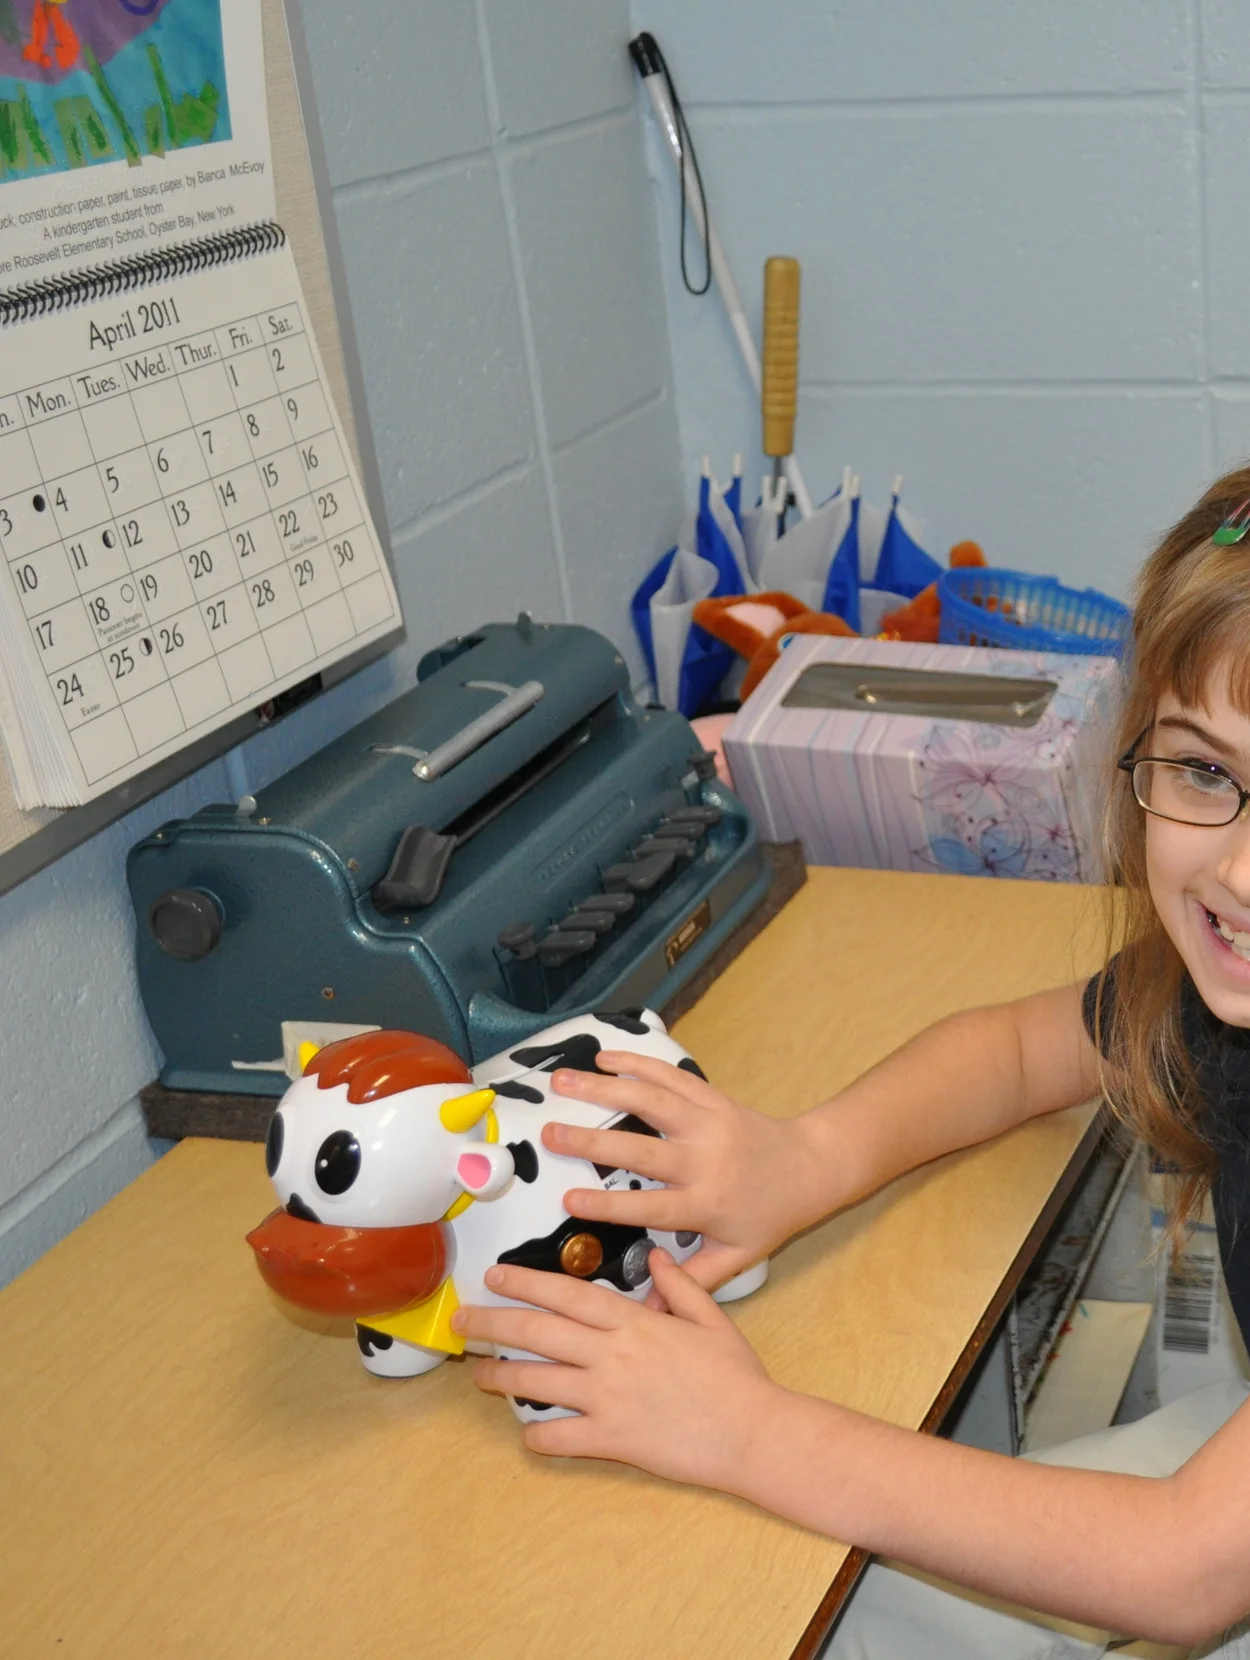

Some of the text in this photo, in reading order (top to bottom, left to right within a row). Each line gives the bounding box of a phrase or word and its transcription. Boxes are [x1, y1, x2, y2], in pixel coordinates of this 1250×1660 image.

[18, 203, 75, 225] construction
[132, 184, 158, 199] tissue
[185, 174, 196, 188] by
[197, 169, 226, 184] Bianca
[229, 161, 265, 177] McEvoy
[43, 203, 164, 240] A kindergarten student from
[13, 248, 62, 270] Roosevelt
[62, 235, 114, 258] Elementary
[148, 219, 176, 237] Oyster
[197, 210, 216, 223] New
[216, 204, 235, 217] York
[90, 297, 181, 351] April 2011
[25, 392, 71, 418] Mon.
[77, 375, 120, 399] Tues.
[125, 352, 170, 382] Wed.
[174, 343, 217, 366] Thur.
[228, 327, 253, 349] Fri.
[268, 315, 293, 336] Sat.
[229, 348, 285, 387] 1 2
[0, 398, 298, 537] 3 4 5 6 7 8 9
[16, 444, 319, 594] 10 11 12 13 14 15 16
[35, 492, 338, 650] 17 18 19 20 21 22 23
[56, 540, 354, 706] 24 25 26 27 28 29 30
